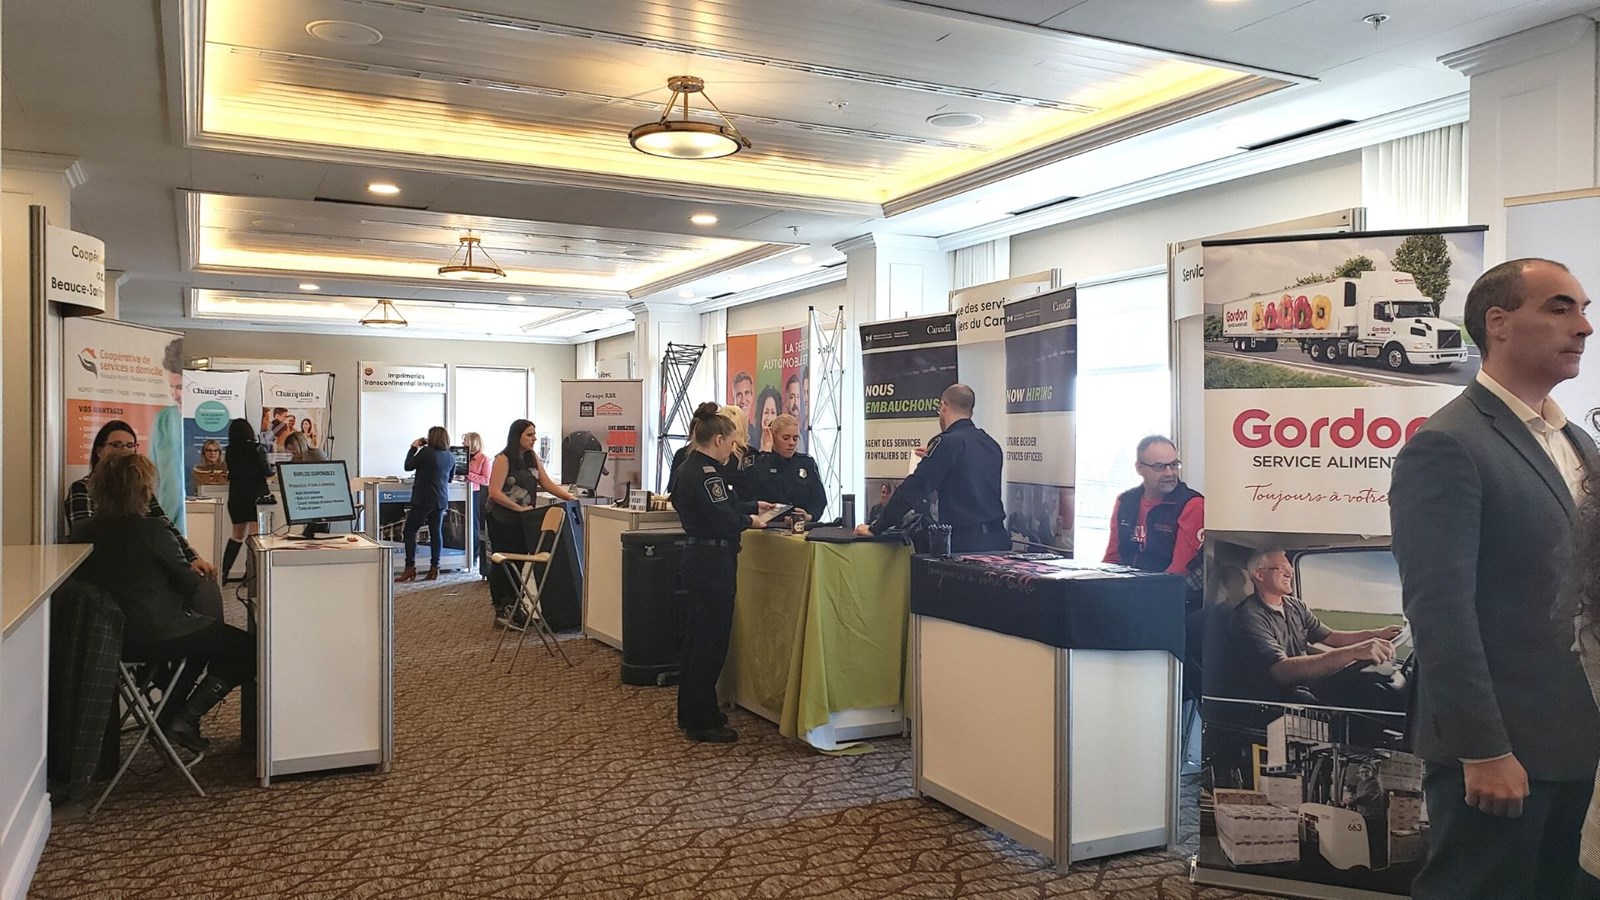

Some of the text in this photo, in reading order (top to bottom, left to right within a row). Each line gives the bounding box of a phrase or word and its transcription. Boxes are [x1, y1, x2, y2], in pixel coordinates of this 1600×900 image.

[964, 302, 979, 314] des
[980, 297, 1010, 311] servi
[1052, 298, 1071, 312] Canada
[1226, 309, 1248, 322] Gordon
[926, 323, 951, 334] Canada
[970, 317, 981, 329] du
[784, 342, 794, 354] LA
[100, 350, 150, 364] Coopérative de
[100, 362, 128, 373] services
[135, 365, 163, 376] domicile
[388, 372, 425, 380] Imprimeries
[192, 387, 232, 396] Champlain
[275, 390, 314, 398] Champlain
[865, 384, 895, 397] NOUS
[1006, 385, 1053, 403] NOW HIRING
[78, 405, 92, 413] VOS
[865, 398, 940, 413] EMBAUCHONS
[865, 438, 921, 447] AGENT DES SERVICES
[865, 451, 908, 460] FRONTALIERS DE
[1252, 455, 1397, 469] SERVICE ALIMEN
[1245, 483, 1390, 511] Toujours à votre
[1347, 823, 1362, 832] 663
